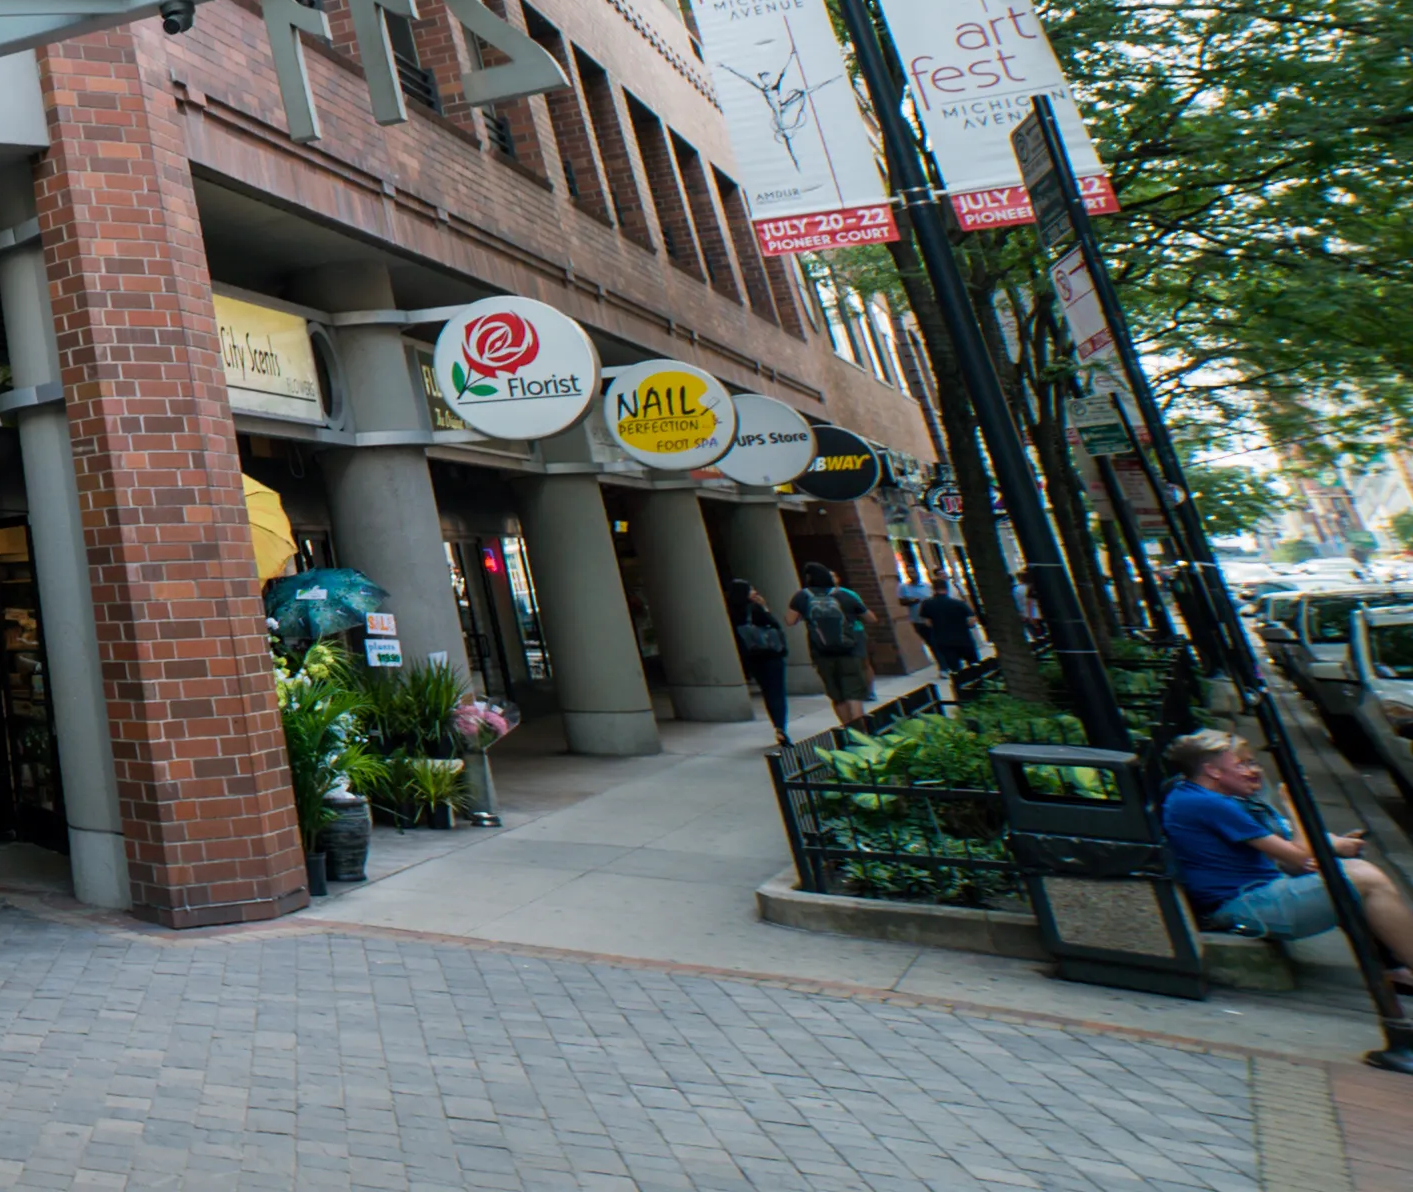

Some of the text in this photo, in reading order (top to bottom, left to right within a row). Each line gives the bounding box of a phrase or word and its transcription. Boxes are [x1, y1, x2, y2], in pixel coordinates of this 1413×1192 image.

[956, 7, 1037, 50] art
[911, 49, 1026, 111] fest
[942, 89, 1066, 119] MICHIGN
[964, 109, 1029, 130] AVEN
[958, 188, 1010, 213] JULY
[762, 218, 808, 241] JULY
[767, 226, 890, 251] PIONEER COURT
[220, 326, 281, 381] City Scents
[507, 374, 582, 397] Florist
[617, 385, 696, 420] NAIL
[618, 420, 699, 436] PERFECTION
[737, 432, 808, 447] UPS Store
[656, 438, 718, 452] FOOT SPA
[807, 454, 871, 472] BWAY
